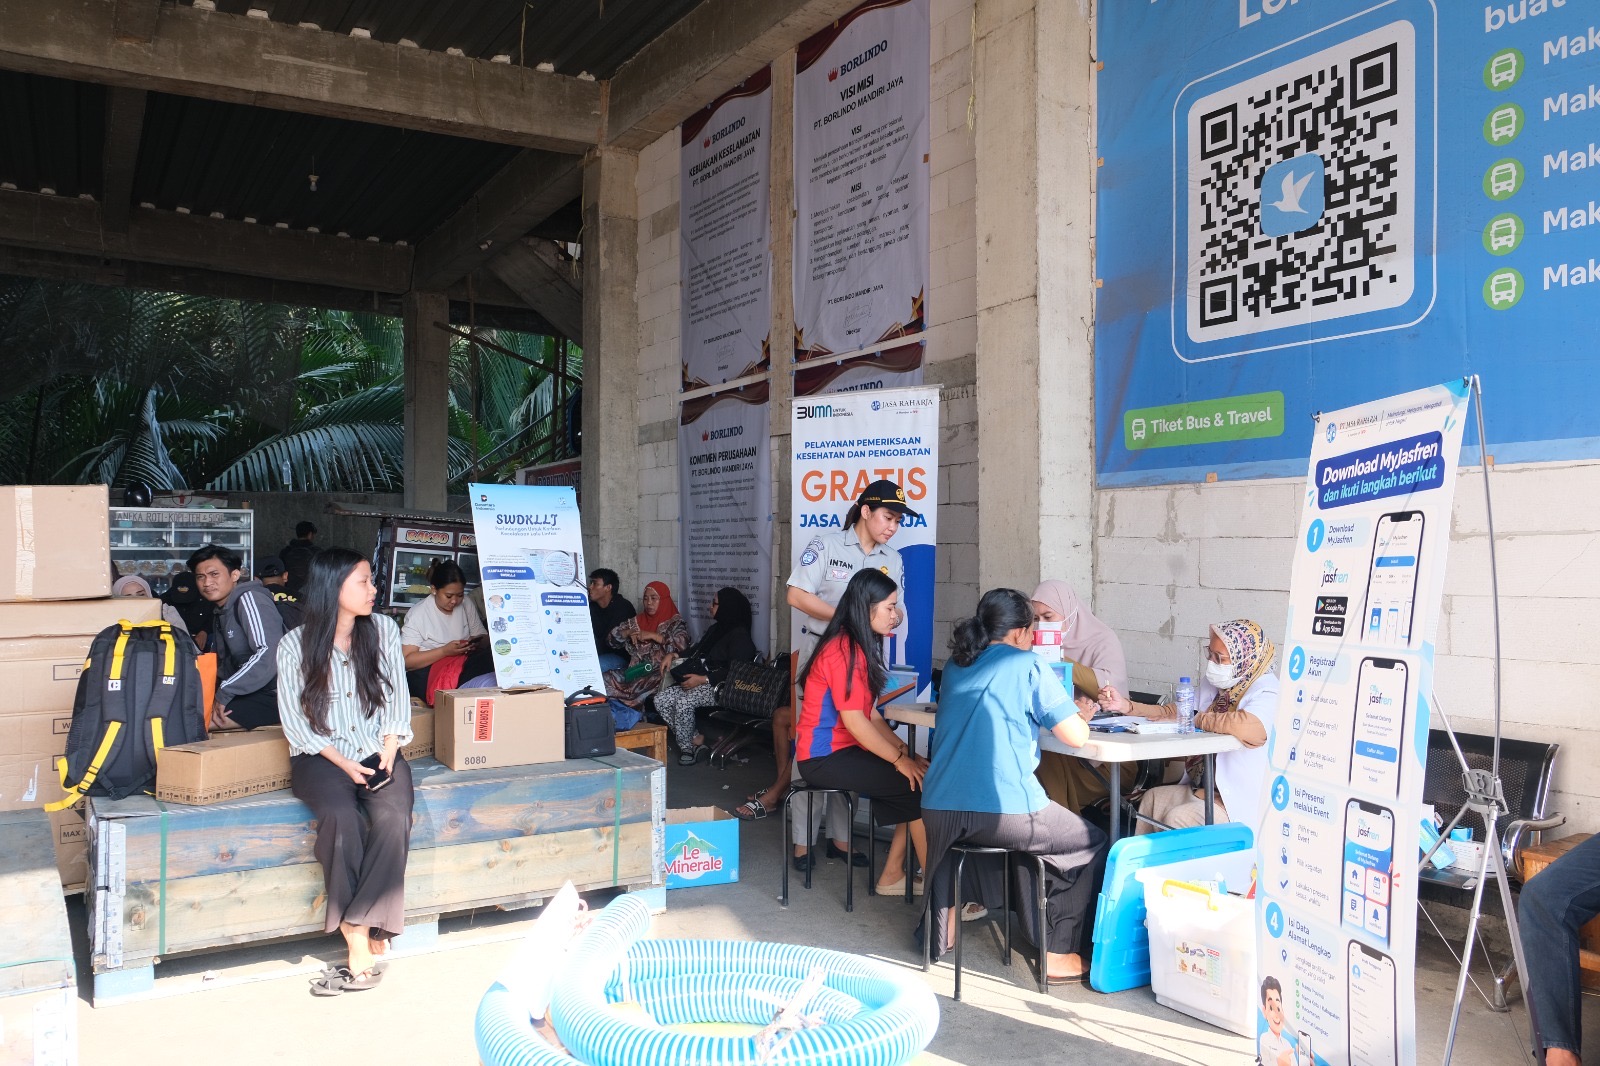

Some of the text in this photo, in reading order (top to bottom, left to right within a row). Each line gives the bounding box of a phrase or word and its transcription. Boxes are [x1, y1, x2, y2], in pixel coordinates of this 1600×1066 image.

[840, 39, 888, 77] BORLINDO
[840, 74, 874, 102] VISI MISI
[813, 76, 904, 131] PT. BORLINDO MANDIRI JAYA
[711, 116, 746, 145] BORLINDO
[851, 124, 862, 136] VISI
[718, 128, 761, 161] KESELAMATAN
[700, 165, 722, 183] BORLINDO
[850, 182, 862, 194] MISI
[1151, 406, 1272, 433] Tiket Bus & Travel
[1339, 422, 1345, 430] PT
[710, 425, 744, 441] BORLINDO
[805, 436, 921, 449] PELAYANAN PEMERIKSAAN
[689, 445, 757, 466] KOMITMEN PERUSAHAAN
[796, 447, 931, 460] KESEHATAN DAN PENGOBATAN
[698, 466, 721, 477] BORLINDO
[721, 464, 741, 473] MANDIRI
[742, 461, 753, 471] JAYA
[1322, 441, 1437, 486] Download MyJasfren
[801, 466, 927, 503] GRATIS
[1323, 464, 1437, 503] dan ikuti langkah berikut
[496, 513, 558, 526] SWDKLLJ
[800, 514, 841, 528] JASA
[1312, 527, 1319, 546] 1
[1329, 523, 1355, 534] Download
[405, 530, 449, 544] BAKSO
[829, 558, 853, 570] INTAN
[1292, 654, 1300, 674] 2
[1309, 655, 1336, 668] Registrasi
[1308, 667, 1322, 677] Akun
[162, 676, 176, 685] CAT
[464, 755, 487, 765] 8080
[1276, 783, 1285, 804] 3
[1294, 787, 1325, 805] Isi Presensi
[1313, 806, 1329, 819] Event
[62, 830, 81, 838] MAX
[684, 845, 700, 861] Le
[664, 856, 722, 874] Minerale
[1270, 911, 1279, 931] 4
[1296, 921, 1310, 935] Data
[1287, 930, 1332, 960] Alamat Lengkap
